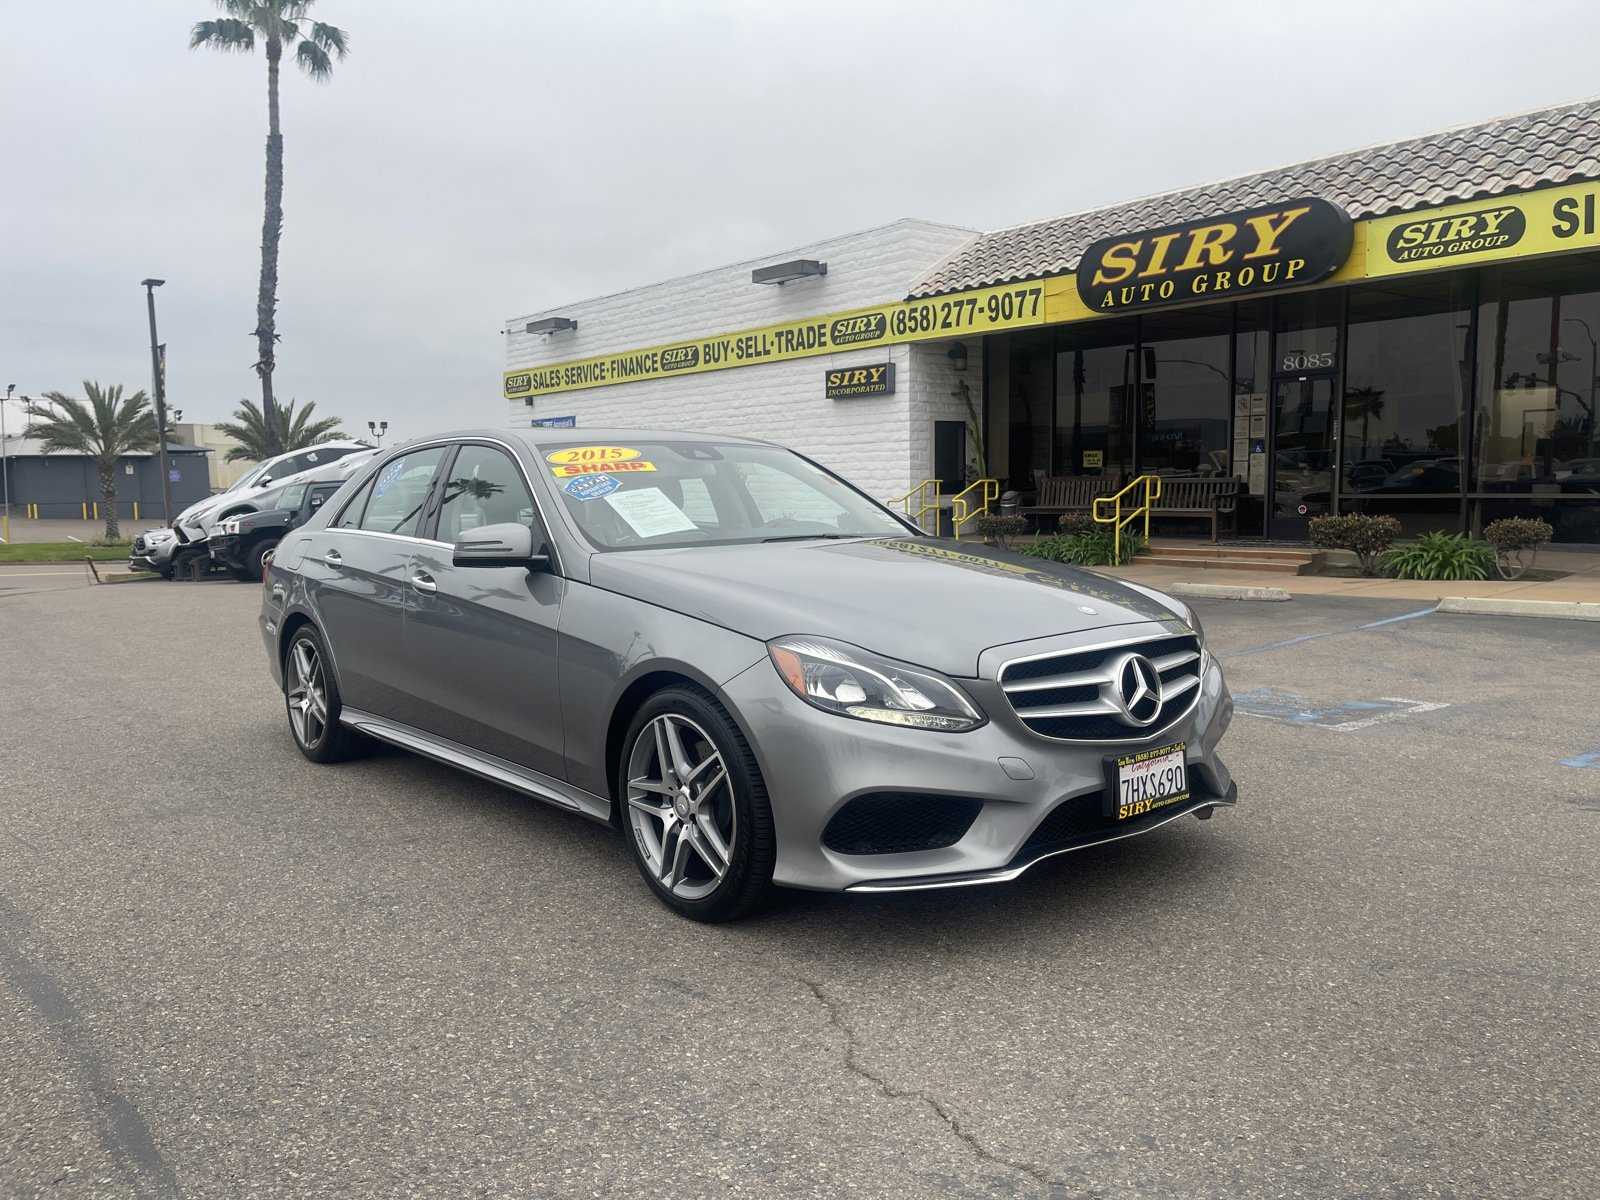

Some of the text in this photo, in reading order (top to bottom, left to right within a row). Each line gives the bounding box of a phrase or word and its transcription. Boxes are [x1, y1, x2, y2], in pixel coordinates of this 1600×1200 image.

[1396, 208, 1515, 250] SIRY
[1091, 206, 1312, 287] SIRY
[1398, 234, 1510, 261] AUTO GROUP
[1101, 258, 1305, 309] AUTO GROUP
[889, 287, 1042, 337] (858) 277-9077
[833, 313, 884, 337] SIRY
[662, 346, 696, 364] SIRY
[1283, 353, 1333, 371] 8085
[507, 375, 530, 388] SIRY
[827, 367, 885, 387] SIRY
[828, 383, 886, 397] INCORPORATED
[567, 448, 623, 463] 2015
[565, 462, 646, 475] SHARP
[1121, 765, 1183, 806] 7HXS690
[1119, 798, 1153, 819] SIRY
